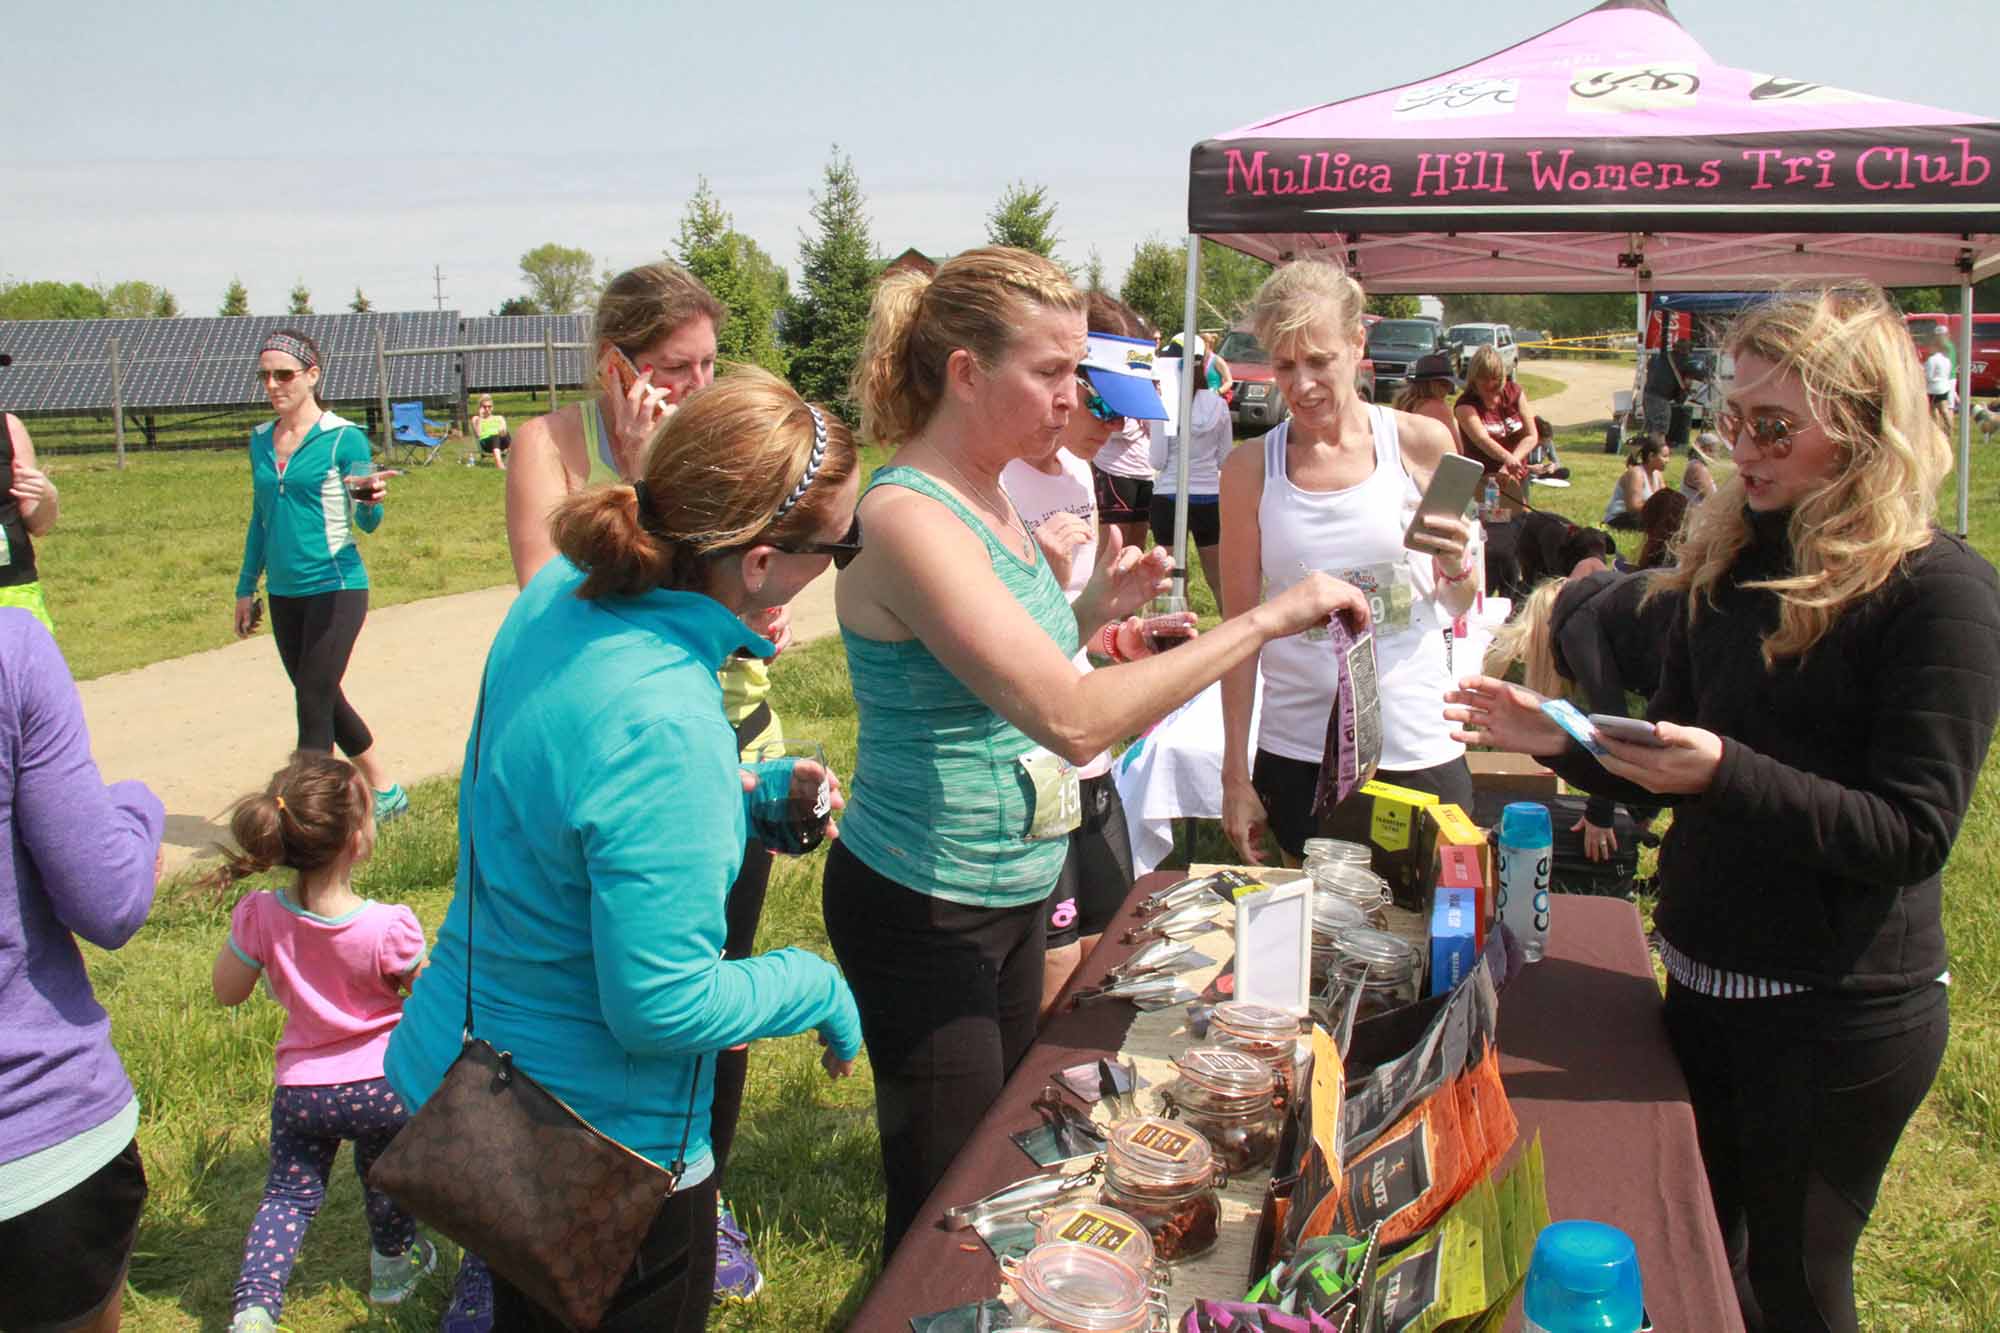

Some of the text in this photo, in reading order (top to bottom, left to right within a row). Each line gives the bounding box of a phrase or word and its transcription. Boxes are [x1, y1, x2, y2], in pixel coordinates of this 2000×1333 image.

[1223, 137, 1991, 197] Mullica Hill Womens Tri Club
[1533, 855, 1551, 932] core
